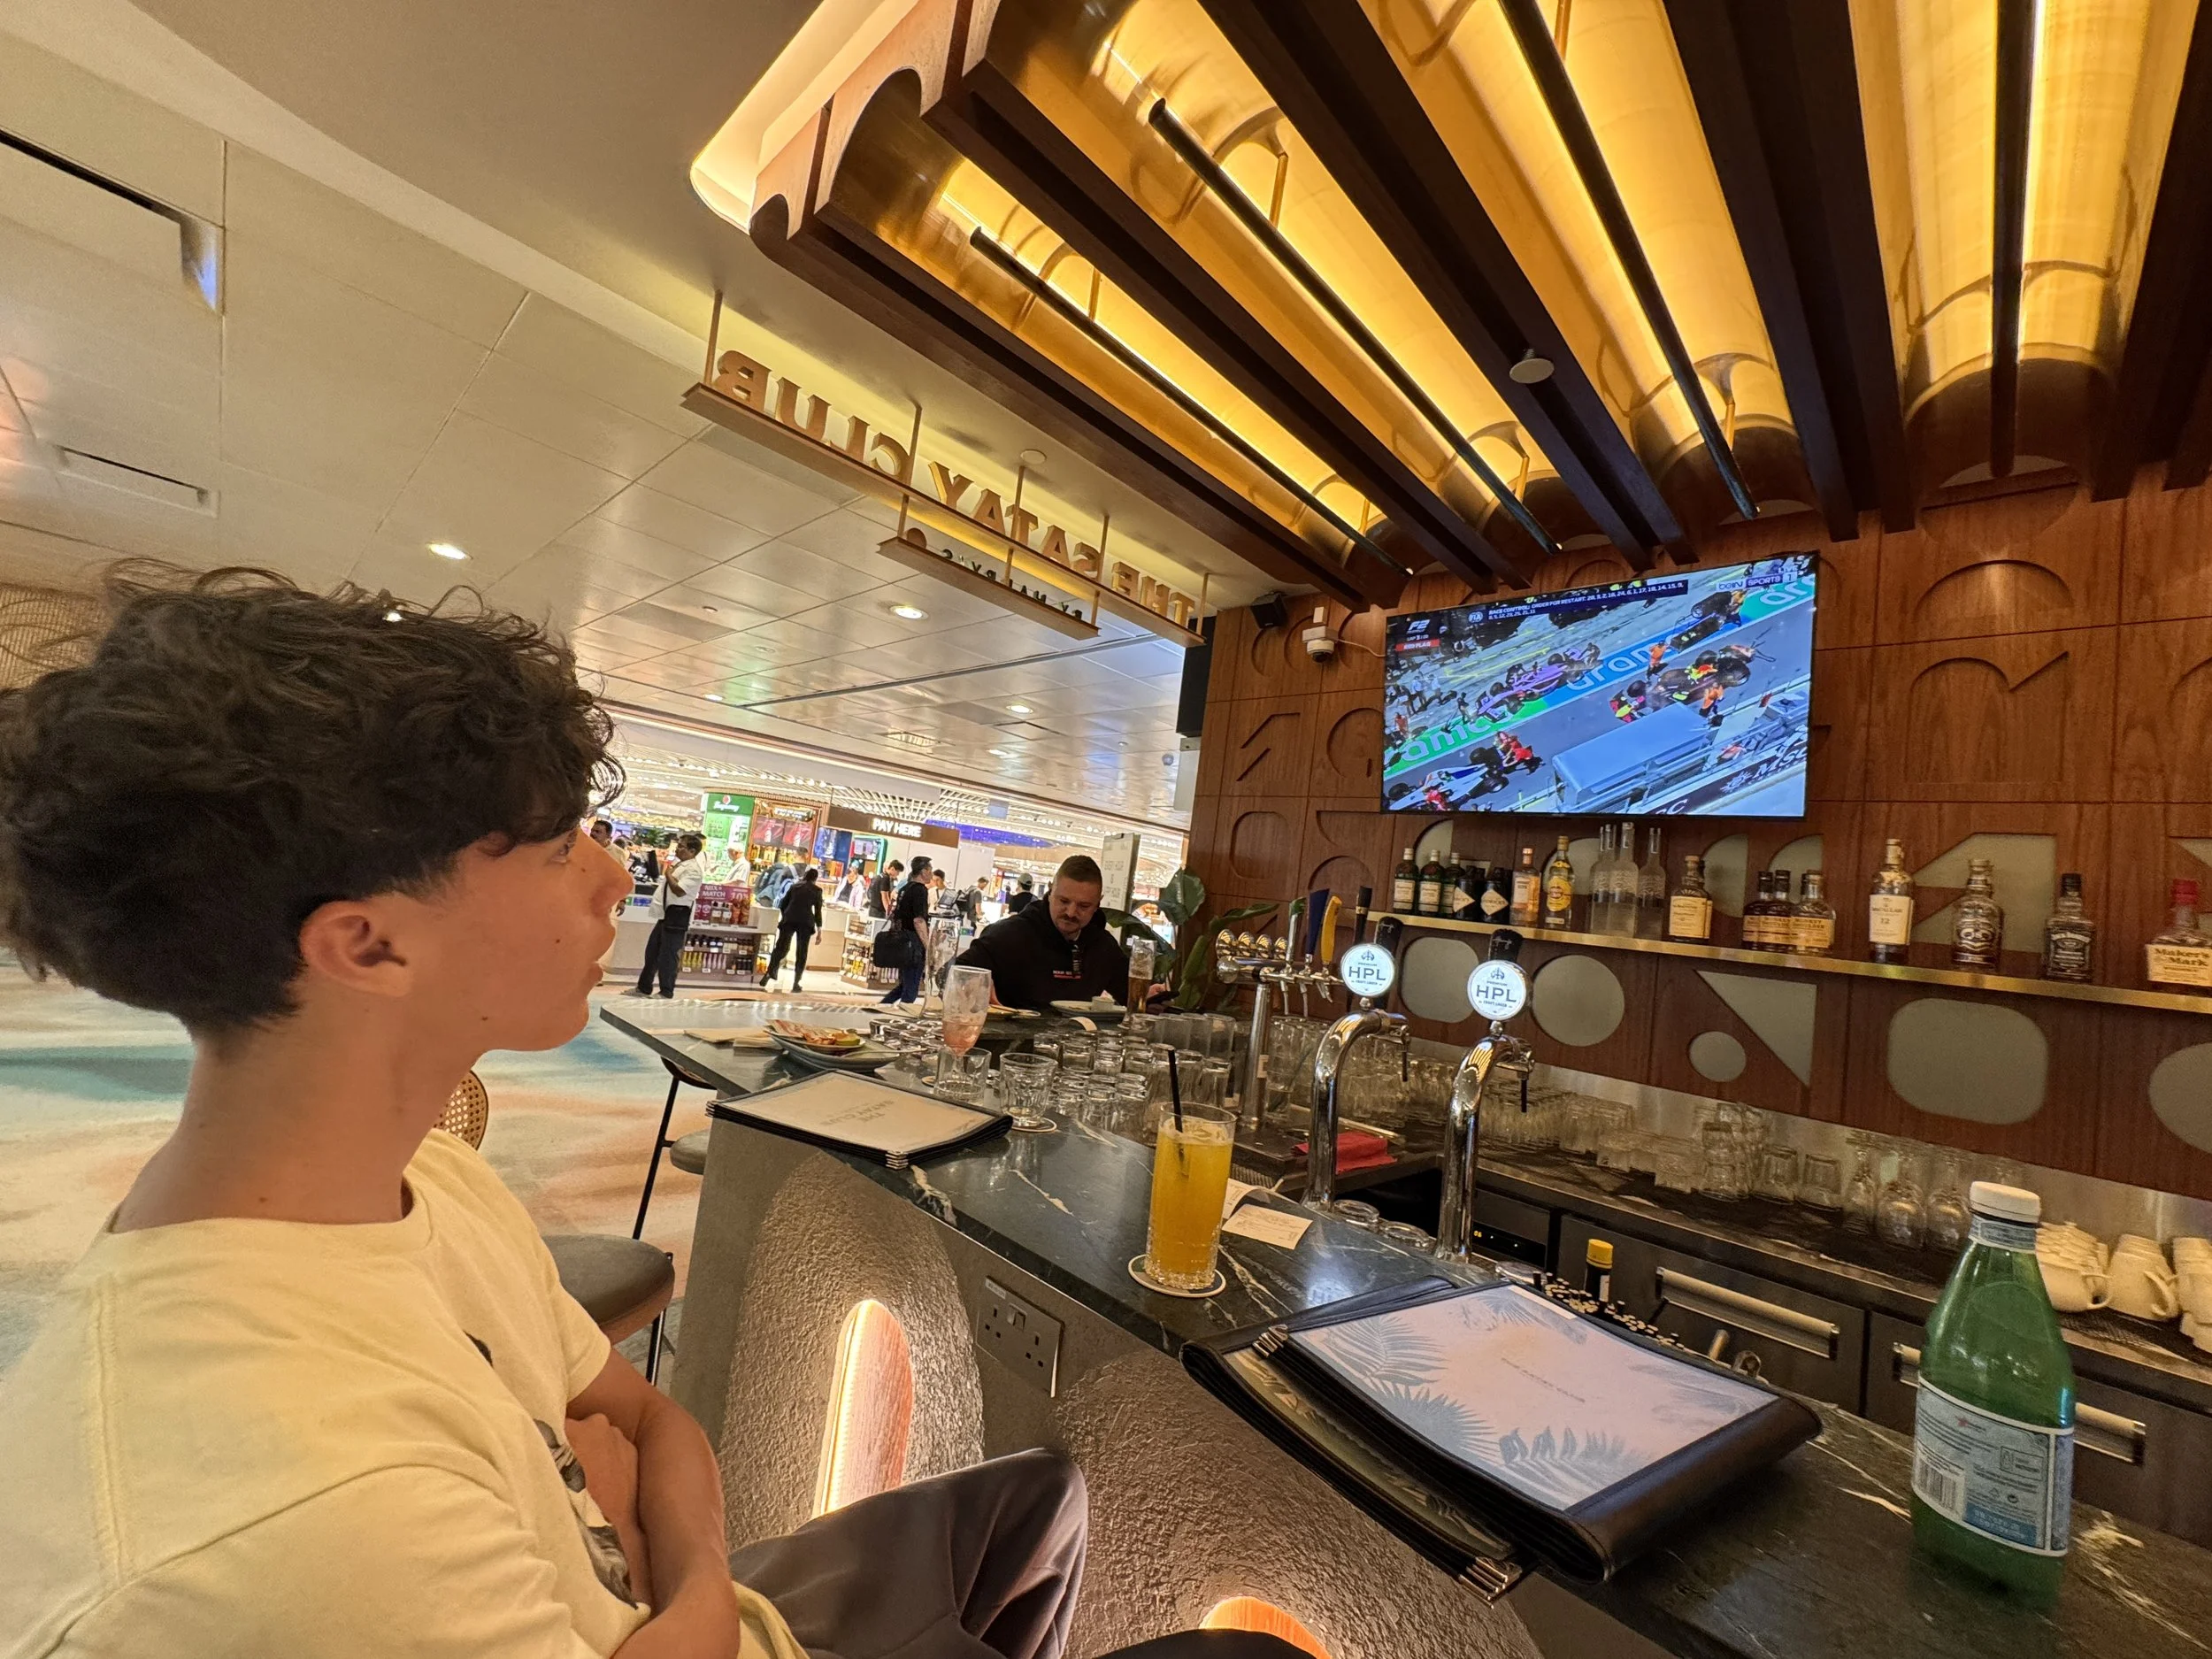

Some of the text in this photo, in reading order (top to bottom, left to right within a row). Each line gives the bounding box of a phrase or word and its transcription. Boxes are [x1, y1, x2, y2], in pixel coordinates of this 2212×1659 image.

[1718, 580, 1744, 590] beIN
[1747, 575, 1781, 587] SPORTS
[1469, 612, 1481, 622] FIA
[1409, 619, 1431, 631] F2
[872, 818, 922, 838] PAY HERE
[2169, 956, 2208, 966] Mark
[1348, 966, 1386, 981] HPL
[1476, 985, 1517, 1002] HPL
